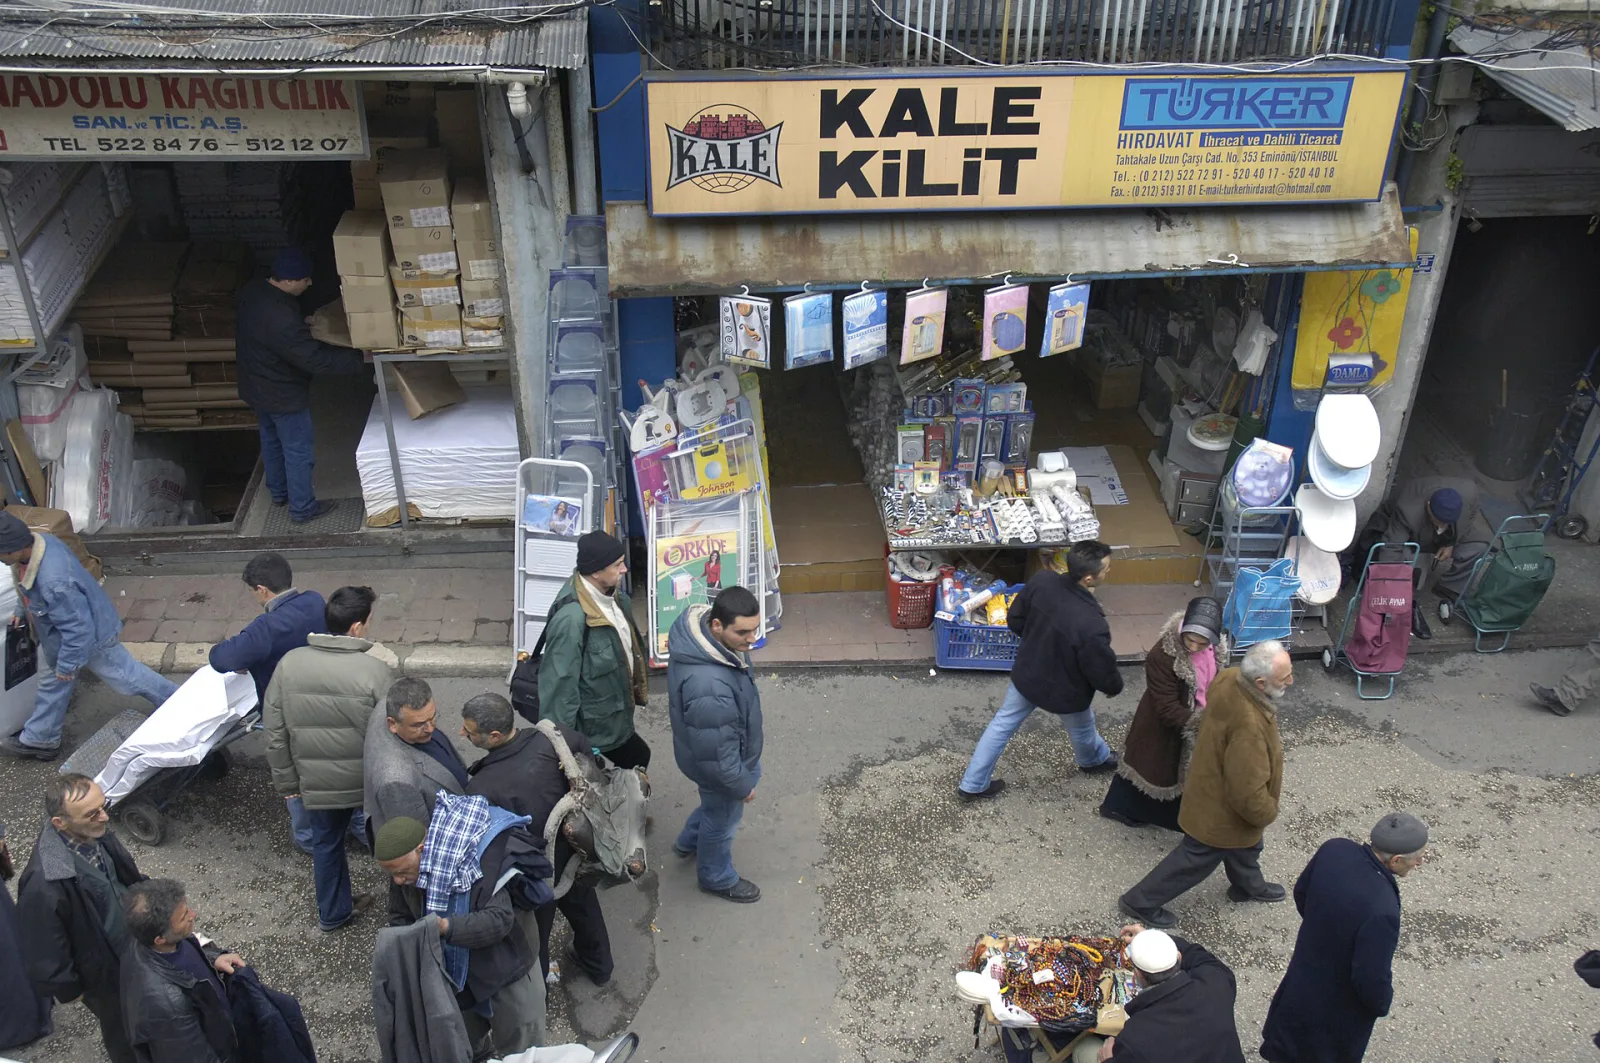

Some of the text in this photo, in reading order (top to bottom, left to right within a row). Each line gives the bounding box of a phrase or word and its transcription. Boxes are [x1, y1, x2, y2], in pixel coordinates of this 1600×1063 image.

[819, 86, 1043, 139] KALE
[72, 115, 133, 130] SAN.
[134, 122, 148, 130] ve
[43, 137, 87, 152] TEL
[97, 137, 147, 152] 522
[153, 138, 182, 152] 84
[188, 138, 219, 152] 76
[246, 138, 285, 152] 512
[291, 138, 314, 152] 12
[320, 138, 349, 152] 07
[1117, 131, 1338, 149] HIRDAVAT İhracat ve Dahili Ticaret
[674, 132, 773, 181] KALE
[1115, 153, 1157, 166] Tahtakale
[1159, 153, 1180, 165] Uzun
[1181, 152, 1204, 167] Çarşı
[1205, 151, 1223, 164] Cad.
[1225, 151, 1240, 163] No.
[1242, 151, 1259, 163] 353
[1113, 170, 1130, 182] Tel.
[1139, 170, 1150, 182] (0
[1151, 169, 1174, 182] 212)
[1176, 169, 1195, 181] 522
[1197, 169, 1209, 180] 72
[1211, 169, 1223, 180] 91
[1232, 168, 1250, 179] 520
[1252, 168, 1265, 179] 40
[1268, 168, 1279, 179] 17
[1288, 168, 1306, 179] 520
[1308, 167, 1320, 179] 40
[1323, 167, 1335, 178] 18
[1110, 186, 1125, 197] Fax.
[1131, 185, 1140, 198] (0
[1141, 185, 1159, 197] 212)
[1160, 185, 1175, 196] 519
[1176, 184, 1185, 196] 31
[1187, 184, 1197, 196] 81
[1332, 367, 1369, 380] DAMLA
[697, 480, 735, 496] Johnson
[1388, 597, 1406, 607] AYNA
